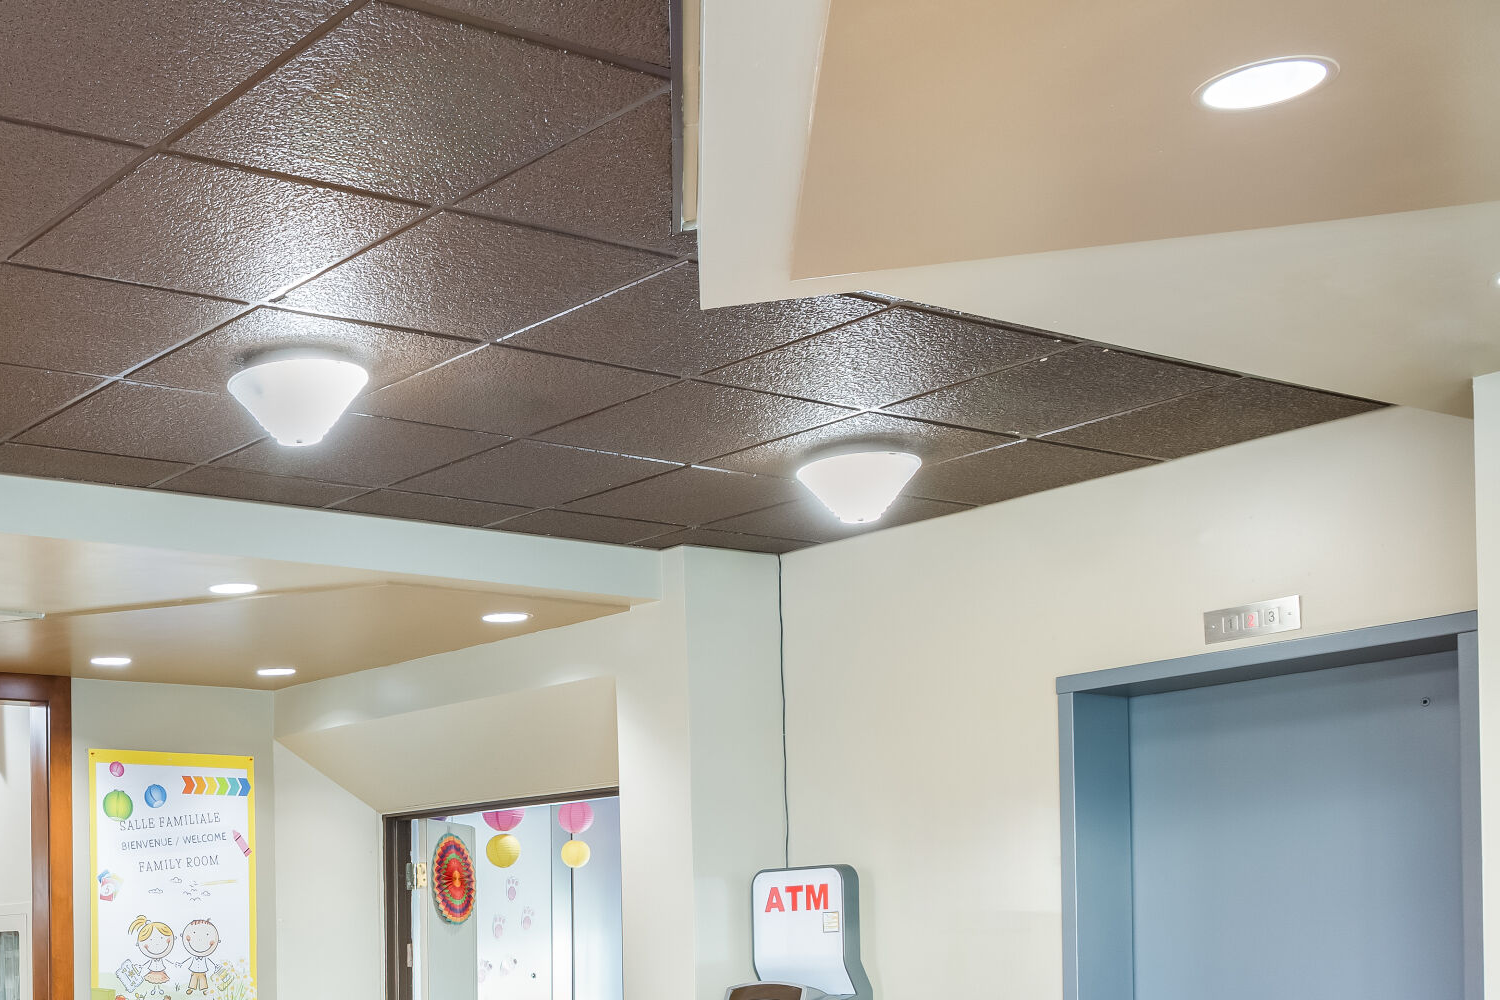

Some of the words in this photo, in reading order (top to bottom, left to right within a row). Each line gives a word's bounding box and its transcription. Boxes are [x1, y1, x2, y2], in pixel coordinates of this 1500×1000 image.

[1227, 618, 1234, 629] 1
[1247, 614, 1256, 628] 2
[1268, 610, 1275, 623] 3
[119, 818, 156, 831] SALLE
[159, 812, 221, 828] FAMILIALE
[121, 837, 173, 851] BIENVENUE
[182, 832, 227, 845] WELCOME
[138, 858, 182, 873] FAMILY
[186, 854, 220, 868] ROOM
[764, 883, 829, 912] ATM
